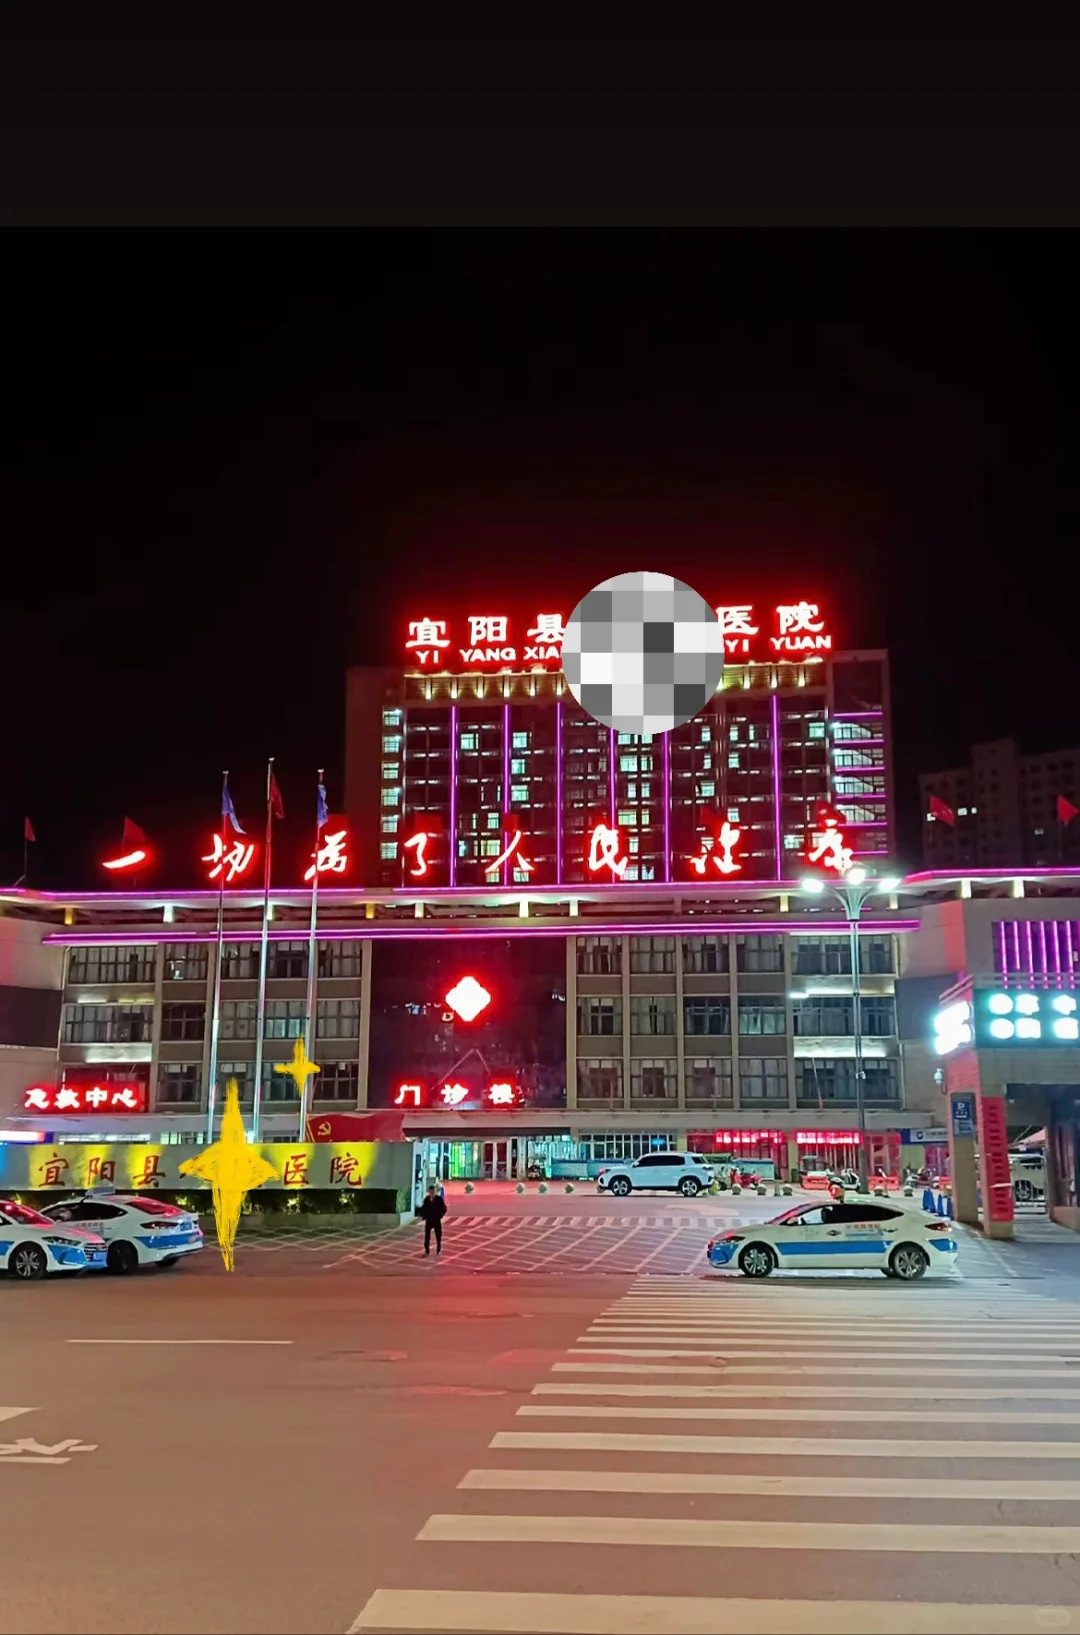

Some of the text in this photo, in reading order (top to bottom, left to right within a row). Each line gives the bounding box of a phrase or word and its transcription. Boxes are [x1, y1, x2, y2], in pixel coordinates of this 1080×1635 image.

[405, 601, 825, 648] 宜阳县 医院
[416, 635, 832, 664] YI YANG XIA YI YUAN
[957, 1102, 965, 1110] P
[39, 1152, 363, 1188] 宜阳县 医院
